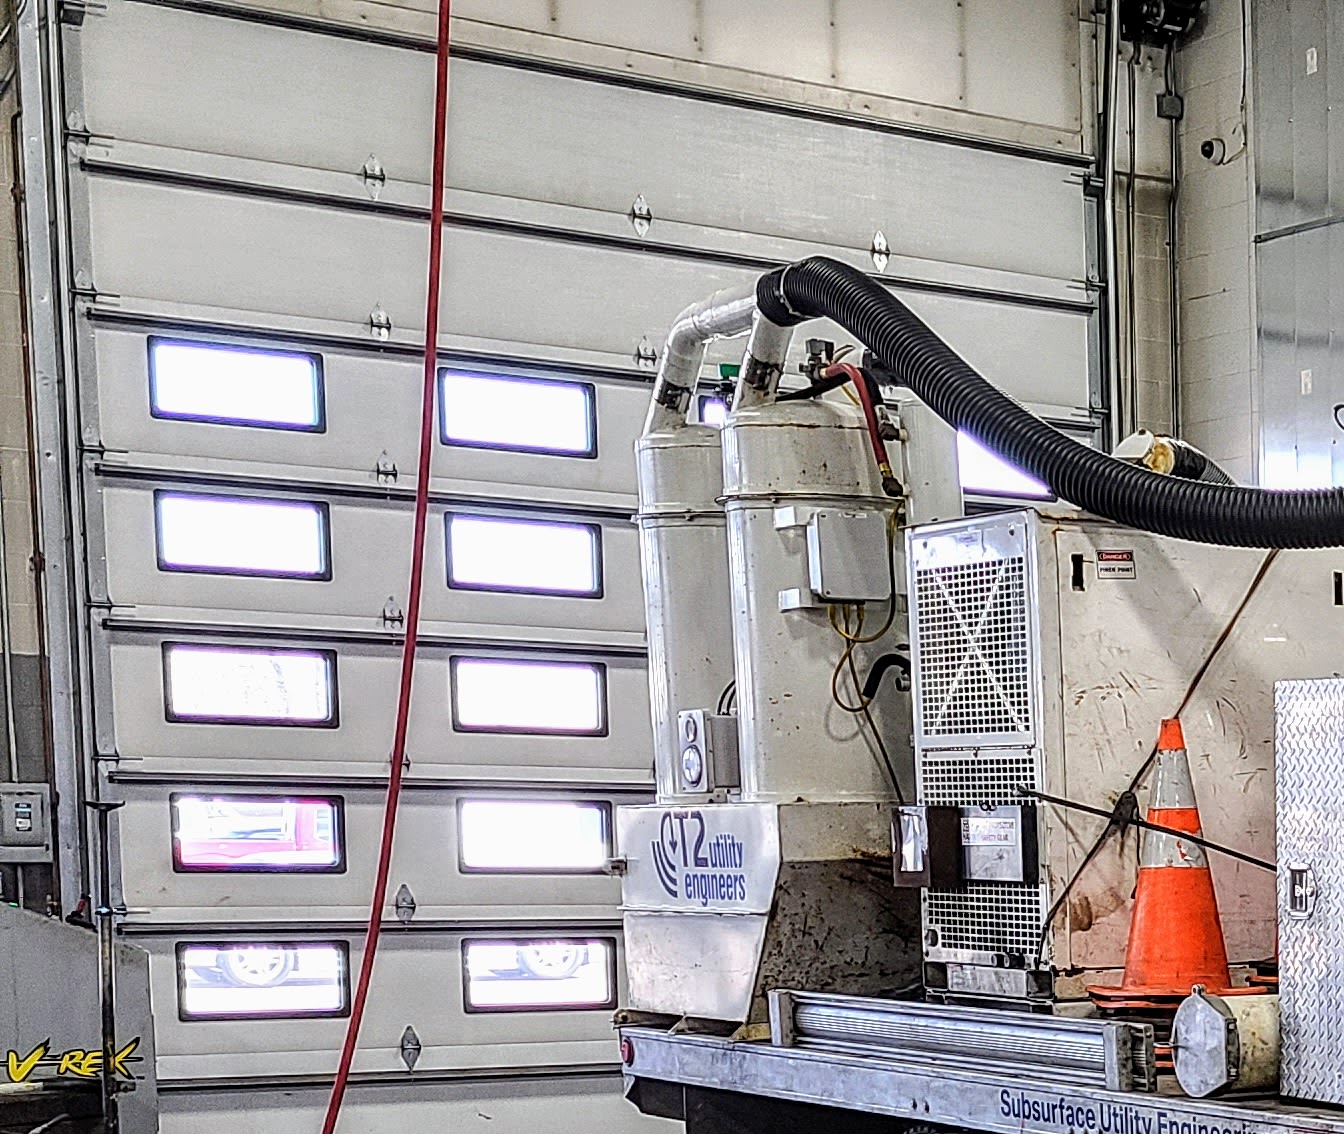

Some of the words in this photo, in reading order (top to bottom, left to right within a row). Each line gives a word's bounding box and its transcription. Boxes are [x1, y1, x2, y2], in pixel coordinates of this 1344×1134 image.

[1102, 551, 1128, 560] DANGER
[672, 810, 709, 868] T2
[709, 834, 743, 869] utility
[685, 873, 746, 908] engineers
[1000, 1089, 1096, 1130] Subsurface
